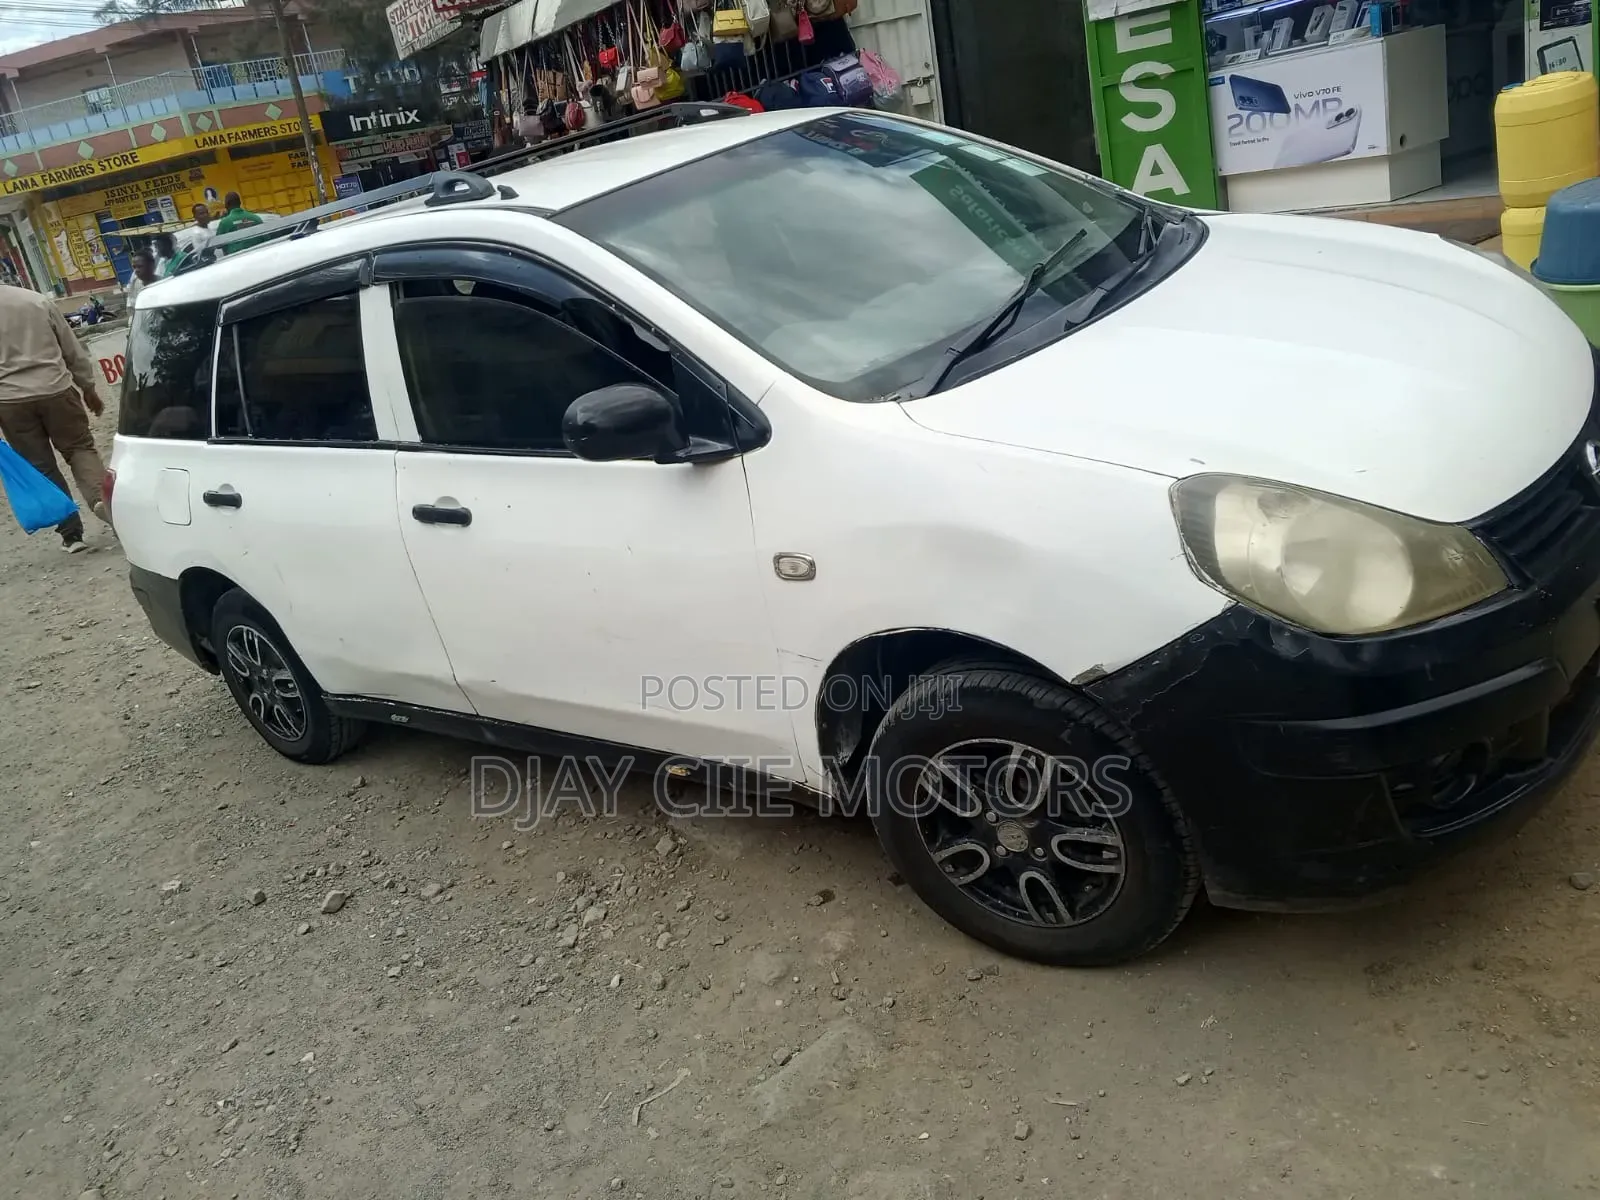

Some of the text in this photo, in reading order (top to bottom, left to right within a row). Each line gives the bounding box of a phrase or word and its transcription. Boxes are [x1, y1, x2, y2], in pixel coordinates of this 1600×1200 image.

[1315, 87, 1331, 97] V70
[1332, 86, 1342, 94] FE
[349, 107, 421, 132] Infinix
[195, 118, 314, 149] LAMA FARMERS STOE
[3, 152, 140, 194] LAMA FARMERS STORE
[104, 173, 182, 199] ISINYA FEEDS
[142, 181, 189, 199] DISTRIBUTOR
